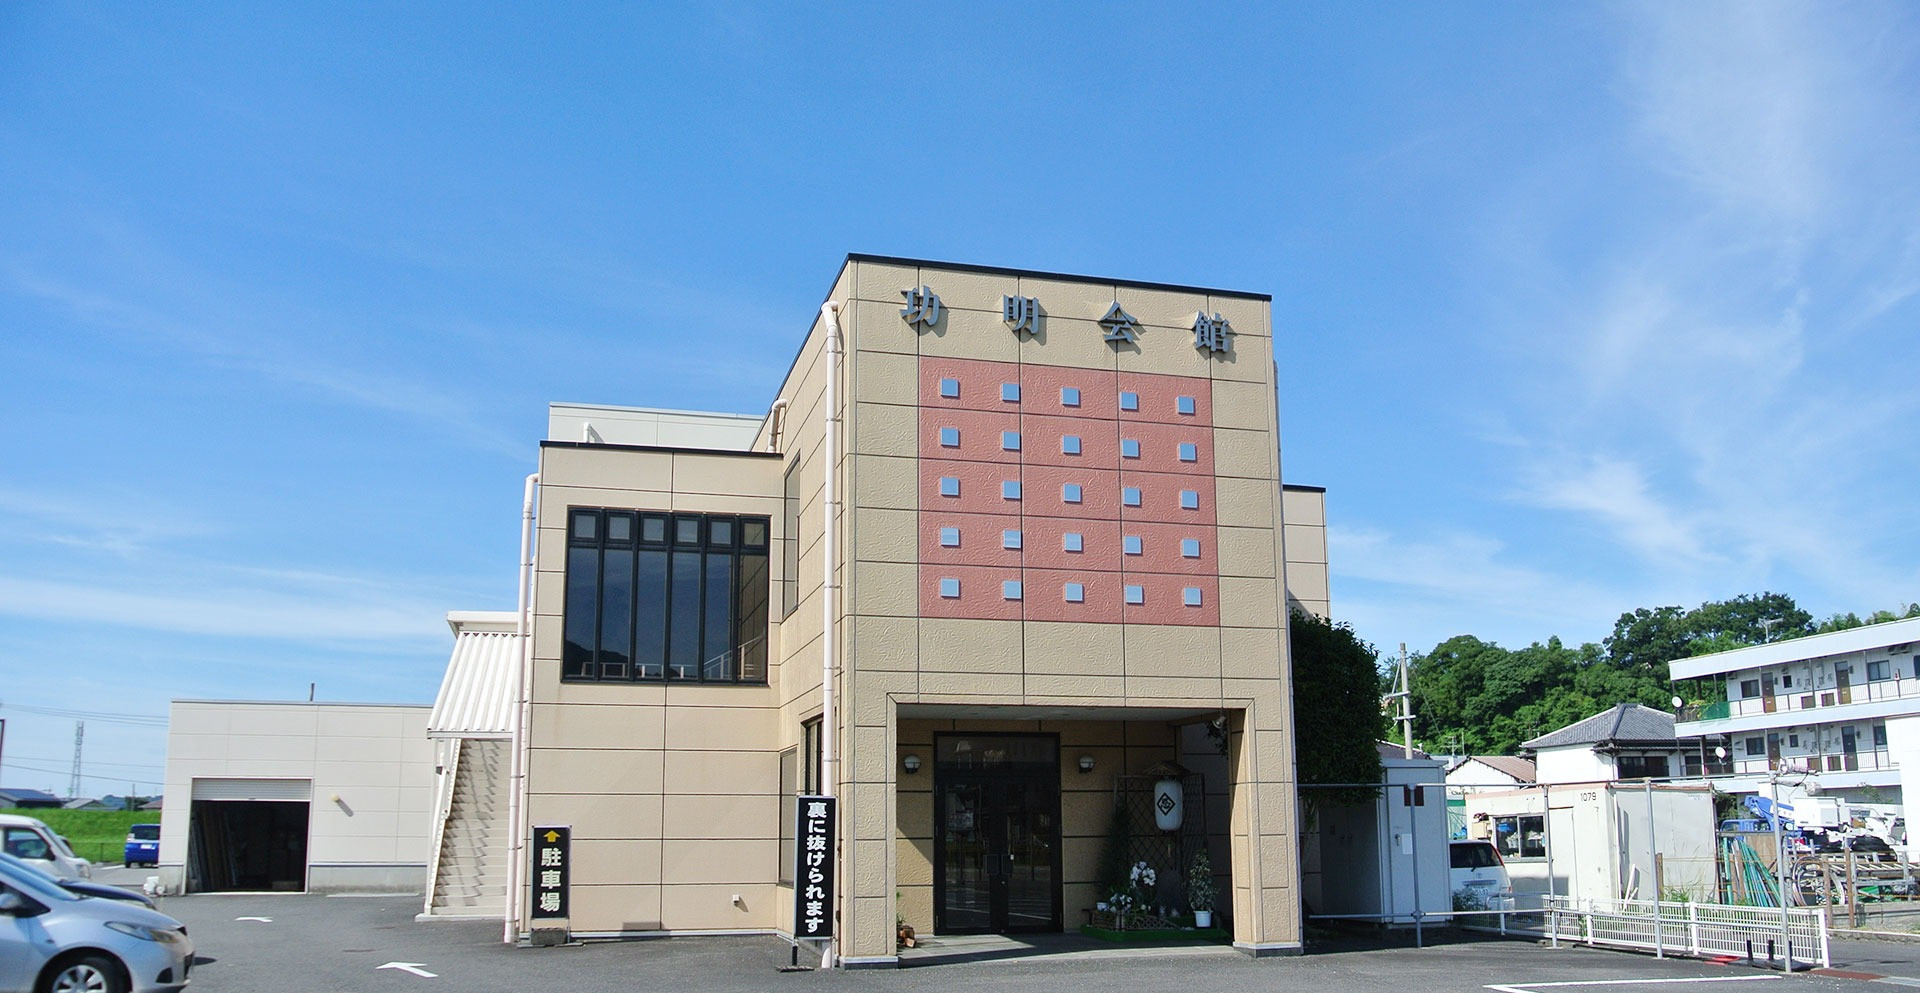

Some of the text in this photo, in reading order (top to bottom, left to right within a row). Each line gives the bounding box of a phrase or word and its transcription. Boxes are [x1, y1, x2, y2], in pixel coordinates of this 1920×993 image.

[900, 285, 1230, 353] 功明会館
[1580, 791, 1597, 802] 1079
[540, 847, 562, 912] 駐車場
[805, 802, 827, 933] 裏に抜けられます
